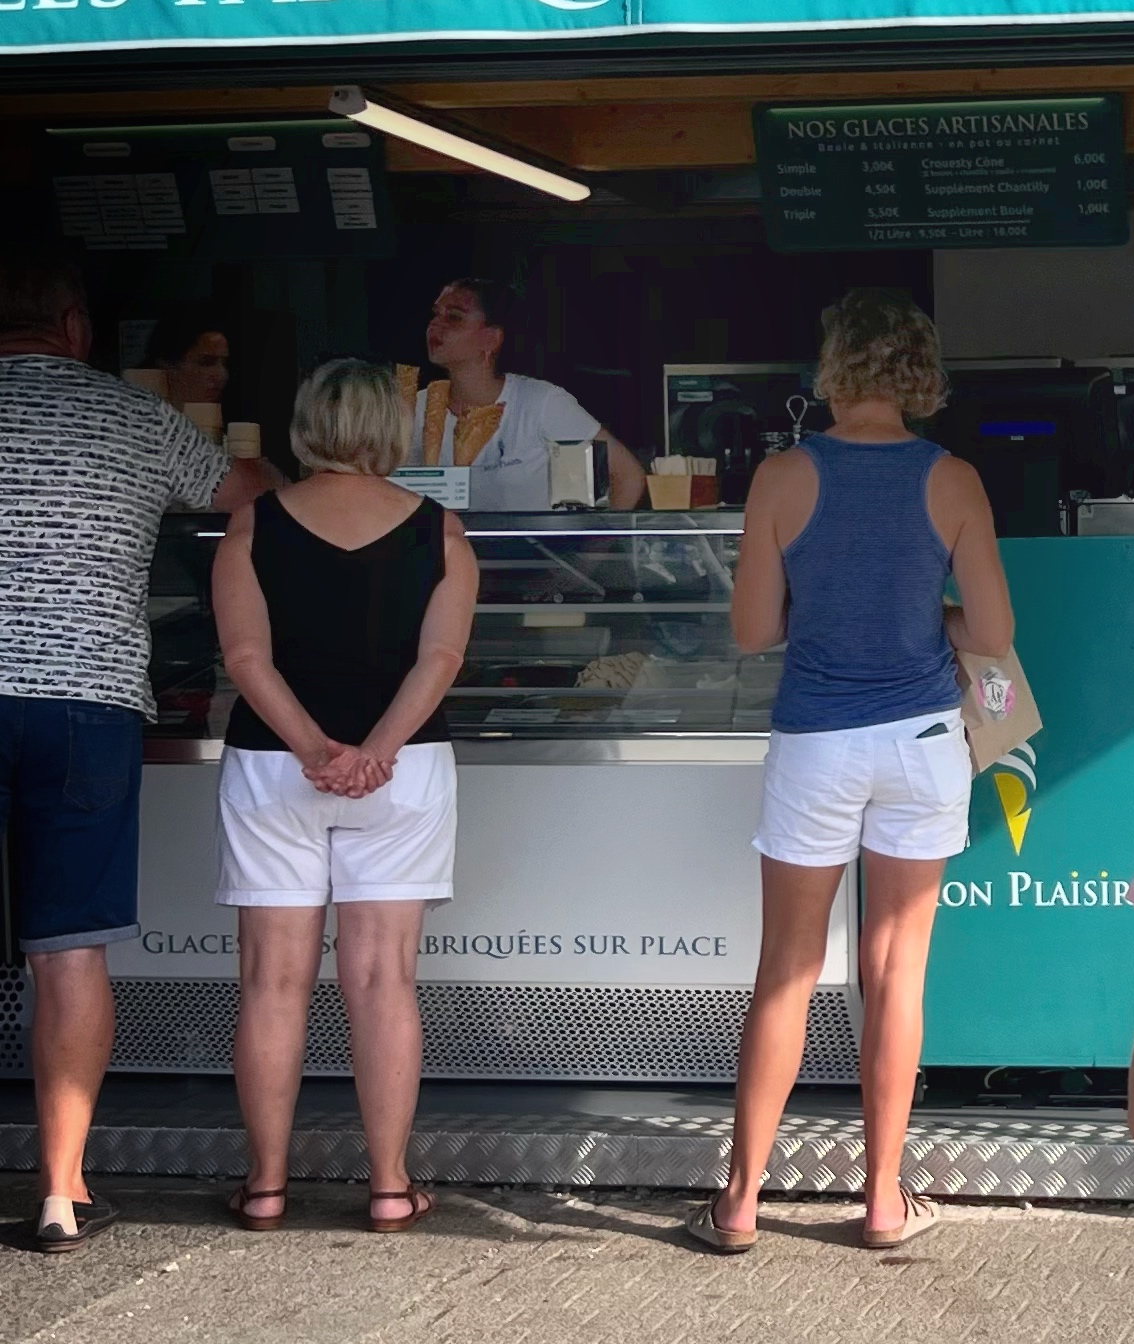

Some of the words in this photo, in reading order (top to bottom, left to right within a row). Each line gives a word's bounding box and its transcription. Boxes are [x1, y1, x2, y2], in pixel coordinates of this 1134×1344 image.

[787, 119, 837, 139] NOS
[843, 116, 929, 138] GLACES
[936, 112, 1089, 135] ARTISANALES
[777, 162, 817, 176] Simple
[862, 160, 895, 173] 3,00€
[783, 209, 817, 221] Triple
[936, 881, 993, 907] ON
[142, 930, 240, 954] GLACE
[414, 929, 562, 959] BRIQUÉES
[574, 934, 630, 956] SUR
[640, 935, 728, 957] PLACE
